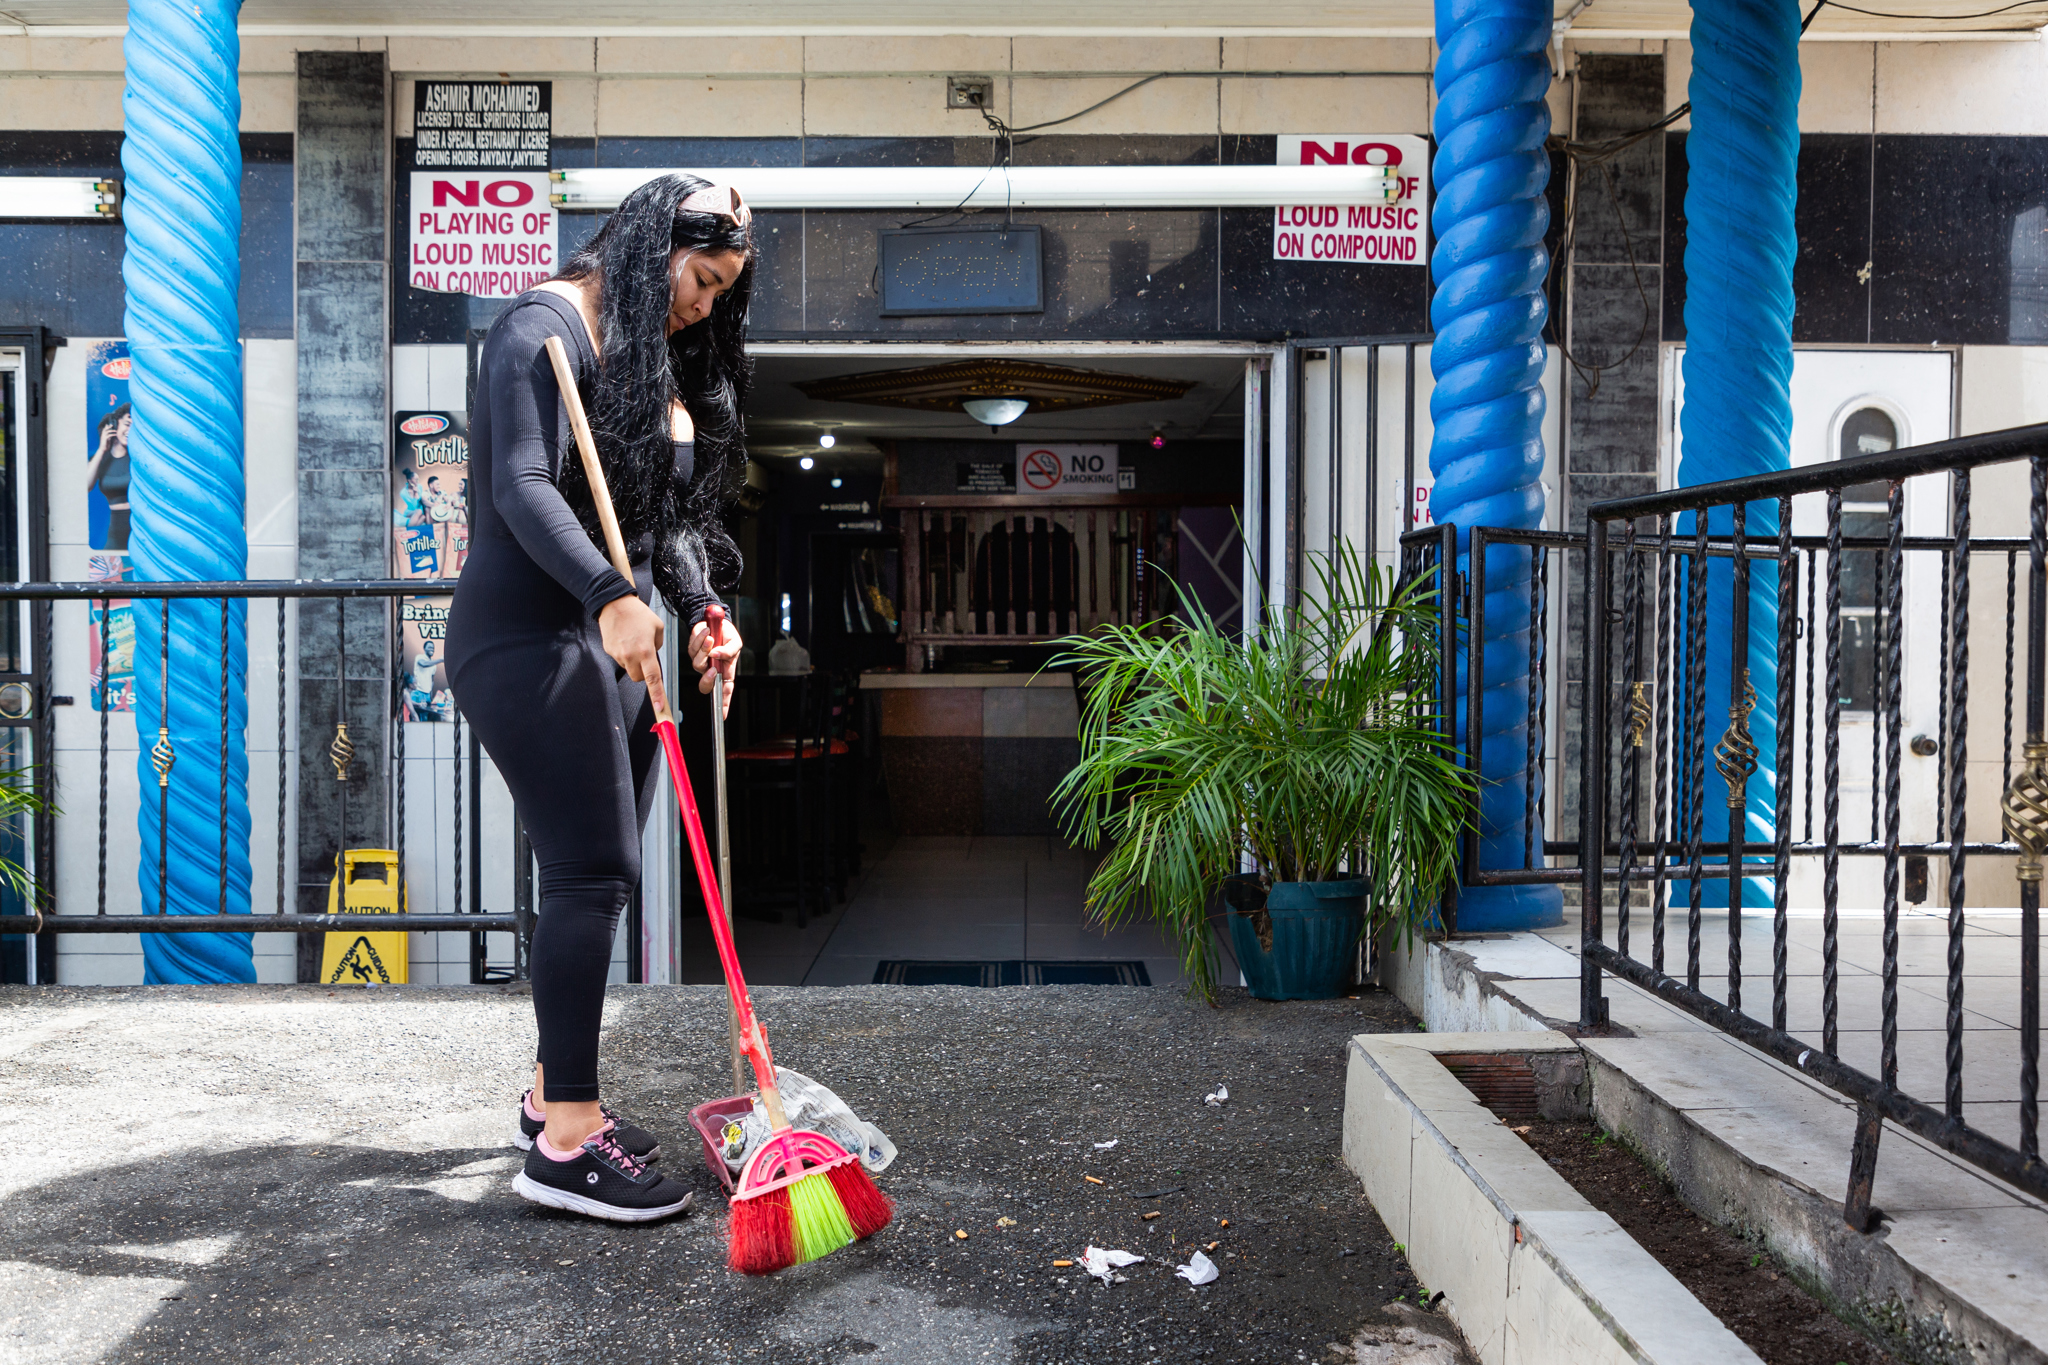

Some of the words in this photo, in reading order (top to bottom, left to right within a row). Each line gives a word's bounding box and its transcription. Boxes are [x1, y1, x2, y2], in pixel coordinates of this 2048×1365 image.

[425, 84, 470, 112] ASHMIR
[472, 84, 540, 112] MOHAMMED
[416, 112, 452, 128] LICENSED
[453, 112, 463, 128] TO
[464, 112, 482, 128] SELL
[483, 112, 521, 129] SPIRITUOS
[522, 112, 549, 129] LIQUOR
[416, 131, 441, 149] UNDER
[441, 131, 447, 149] A
[447, 131, 475, 149] SPECIAL
[476, 131, 520, 149] RESTAURANT
[521, 131, 549, 149] LICENSE
[415, 150, 451, 166] OPENING
[451, 150, 479, 166] HOURS
[1300, 140, 1403, 165] NO
[432, 180, 534, 208] NO
[419, 212, 514, 235] PLAYING
[522, 212, 552, 235] OF
[1278, 206, 1339, 228] LOUD
[1348, 206, 1419, 231] MUSIC
[413, 243, 473, 265] LOUD
[482, 243, 552, 265] MUSIC
[1277, 232, 1304, 258] ON
[1311, 233, 1417, 261] COMPOUND
[413, 271, 440, 291] ON
[896, 254, 1021, 287] OPEN
[408, 418, 438, 432] Holiday
[413, 436, 468, 467] Tortilla
[1071, 455, 1104, 473] NO
[1062, 474, 1114, 484] SMOKING
[401, 535, 441, 555] Tortillaz
[418, 622, 446, 639] Vib
[332, 946, 357, 983] CAUTION
[367, 947, 391, 984] CUIDADO
